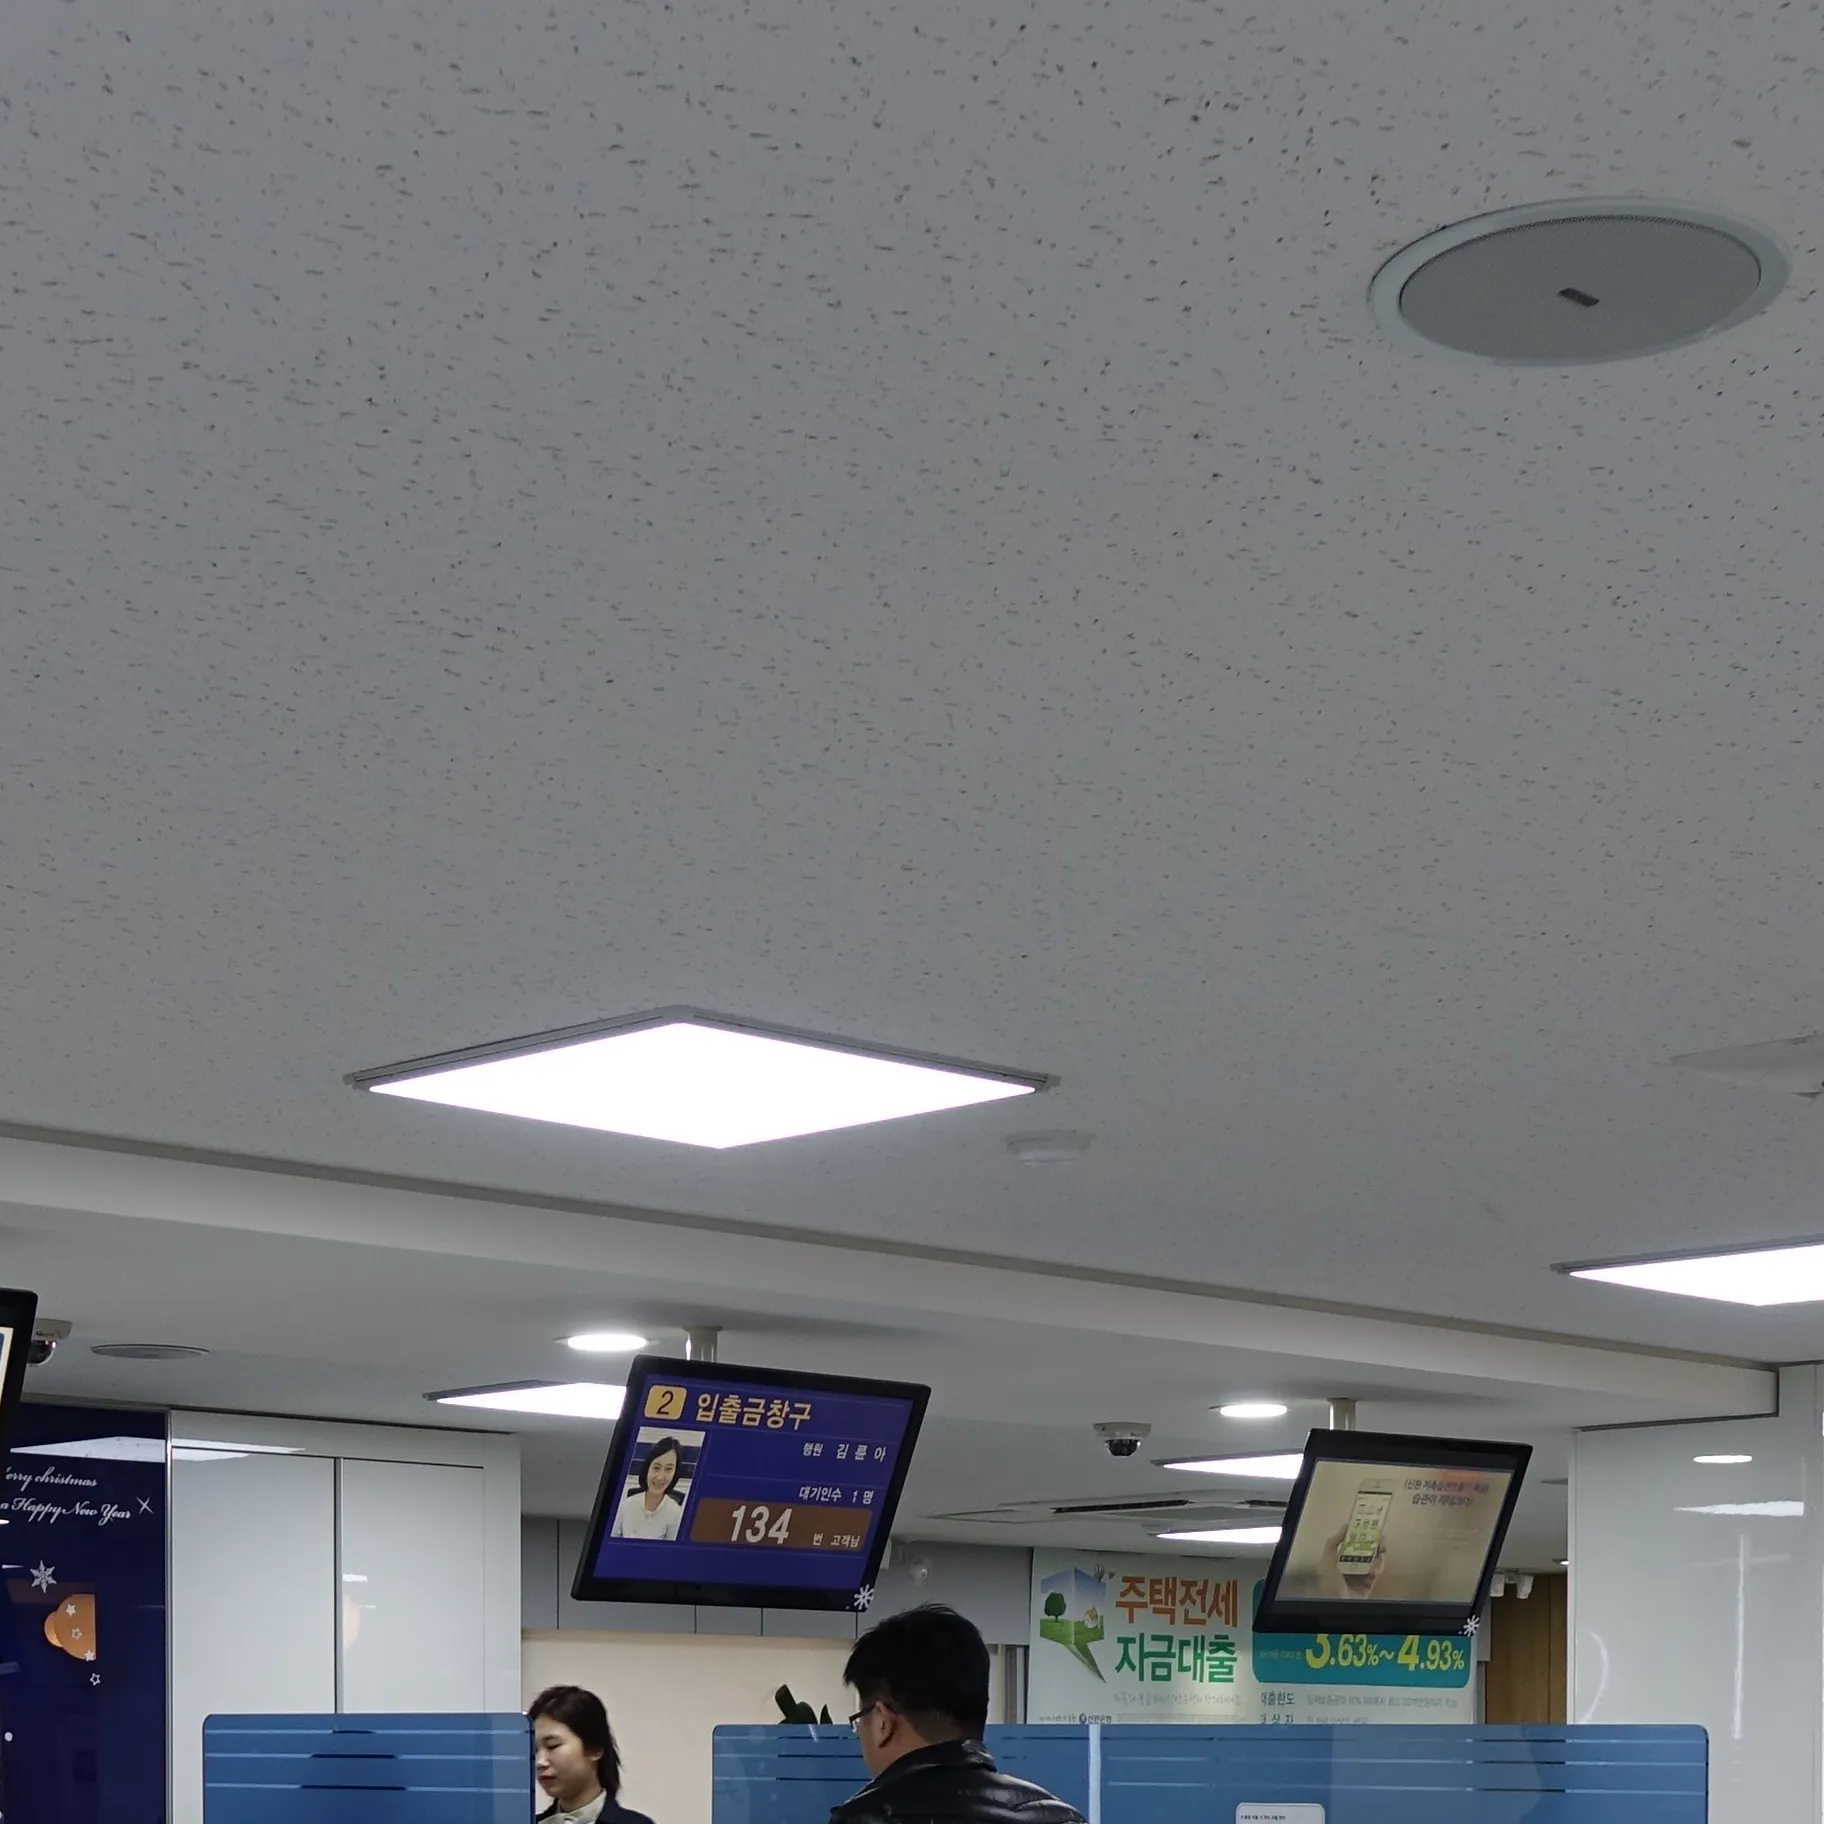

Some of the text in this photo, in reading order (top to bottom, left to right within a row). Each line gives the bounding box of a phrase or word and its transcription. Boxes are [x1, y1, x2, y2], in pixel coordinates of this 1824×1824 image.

[656, 1391, 812, 1431] 2 입출금창구
[5, 1466, 32, 1492] erry
[799, 1485, 874, 1504] 대기인수 1 명
[10, 1497, 63, 1525] Happy
[61, 1501, 98, 1517] New
[98, 1503, 132, 1526] Year
[730, 1505, 793, 1545] 134
[830, 1534, 860, 1548] 고객님
[1115, 1575, 1239, 1628] 주택전세
[1115, 1633, 1238, 1684] 자금대출
